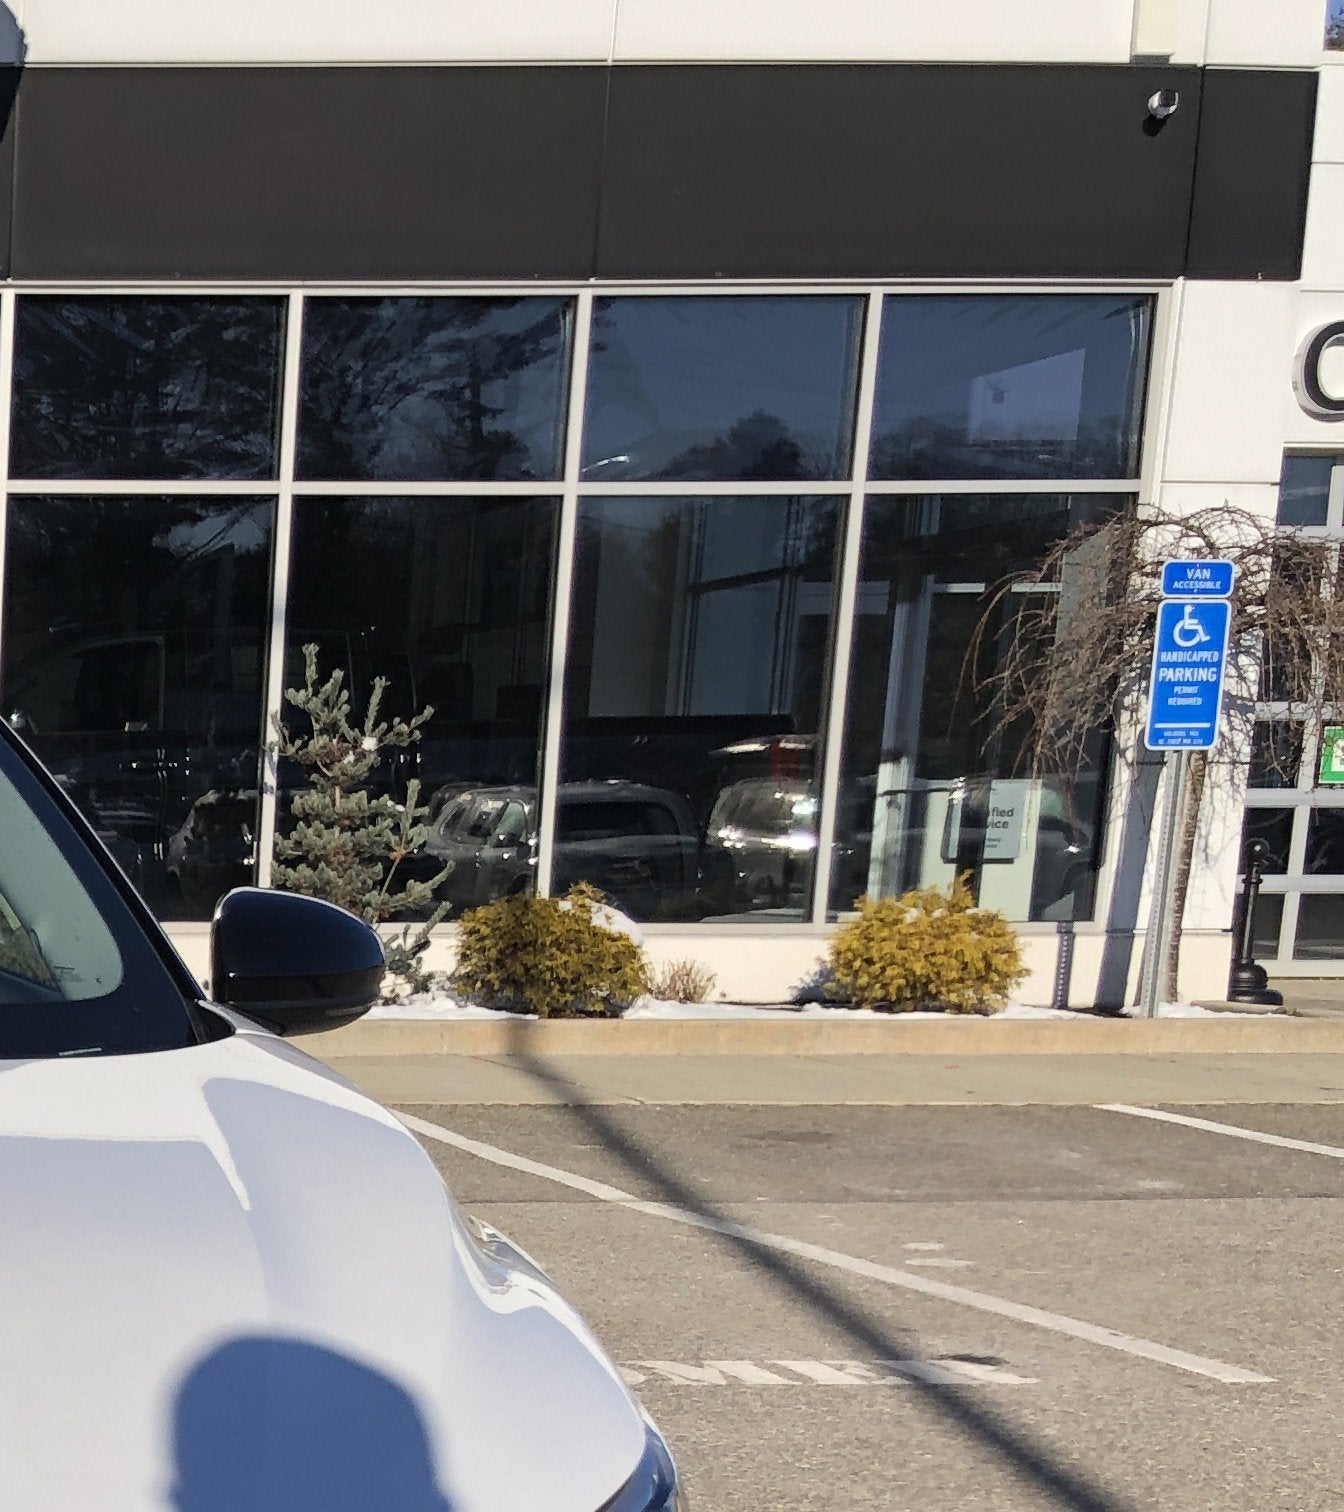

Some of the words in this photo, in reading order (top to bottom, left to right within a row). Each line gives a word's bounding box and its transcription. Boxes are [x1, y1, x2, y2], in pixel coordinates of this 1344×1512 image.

[1186, 568, 1211, 580] VAN
[1172, 580, 1222, 589] ACCESSIBLE
[1160, 650, 1219, 663] HANDICAPPED
[1158, 667, 1218, 682] PARKING
